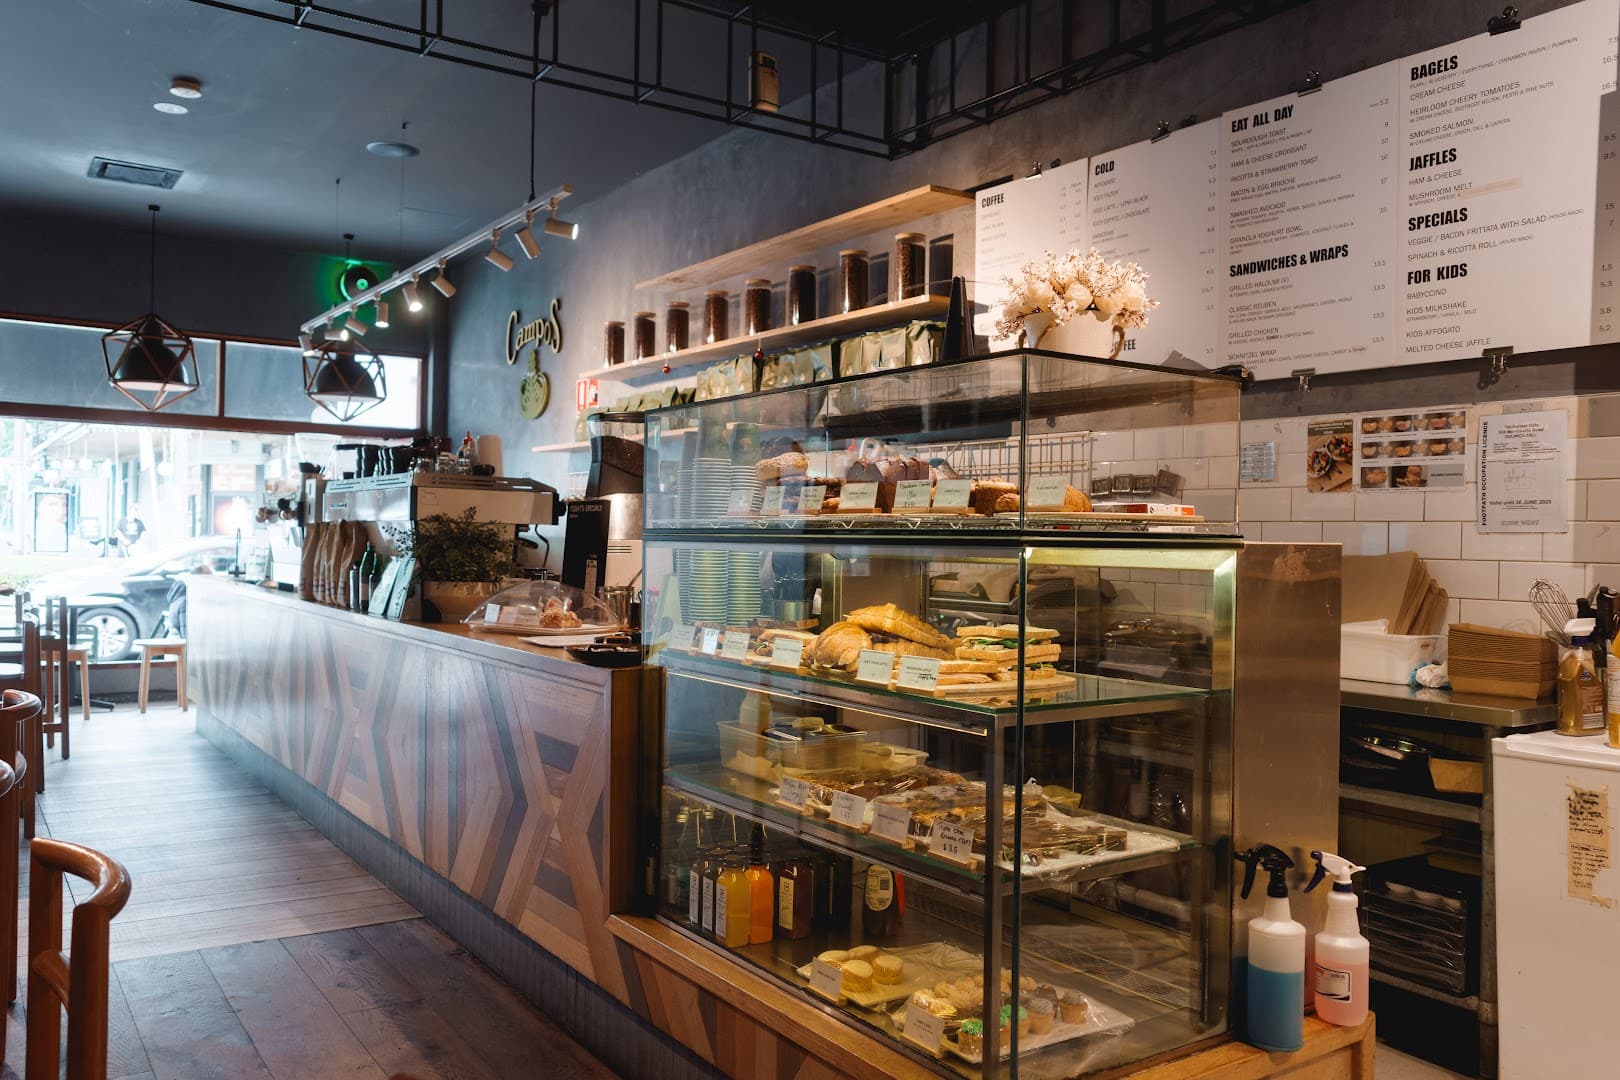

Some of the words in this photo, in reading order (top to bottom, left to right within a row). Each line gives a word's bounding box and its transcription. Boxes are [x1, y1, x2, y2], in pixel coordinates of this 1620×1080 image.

[1411, 56, 1458, 81] BAGELS
[1410, 88, 1436, 100] CREAM
[1437, 80, 1466, 94] CHEESE
[1410, 102, 1447, 116] HEIRLOOM
[1480, 81, 1520, 98] TOMATOES
[1232, 118, 1248, 133] EAT
[1253, 112, 1270, 128] ALL
[1274, 104, 1294, 122] DAY
[1231, 132, 1268, 148] SOURDOUGH
[1269, 128, 1286, 138] TOAST
[1410, 127, 1440, 140] SMOKED
[1442, 118, 1474, 132] SALMON
[1231, 159, 1244, 168] HAM
[1252, 153, 1273, 164] CHEESE
[1274, 144, 1307, 158] CROISSANT
[1409, 148, 1456, 171] JAFFLES
[1095, 160, 1114, 176] COLD
[1230, 173, 1254, 182] RICOTTA
[1260, 161, 1299, 176] STRAWBERRY
[1300, 156, 1318, 166] TOAST
[1409, 177, 1426, 186] HAM
[1434, 168, 1463, 181] CHEESE
[1230, 188, 1250, 197] BACON
[1270, 177, 1296, 188] BRIOCHE
[1409, 186, 1452, 200] MUSHROOM
[1454, 182, 1472, 192] MELT
[982, 193, 1004, 208] COFFEE
[1230, 208, 1258, 218] SMASHED
[1260, 201, 1286, 212] AVOCADO
[1408, 208, 1468, 231] SPECIALS
[1230, 234, 1256, 244] GRANOLA
[1258, 228, 1284, 238] YOGHURT
[1286, 225, 1302, 233] BOWL
[1408, 236, 1432, 246] VEGGIE
[1440, 230, 1465, 240] BACON
[1467, 224, 1498, 234] FRITTATA
[1500, 220, 1519, 230] WITH
[1522, 215, 1546, 226] SALAD
[1230, 254, 1297, 277] SANDWICHES
[1300, 255, 1307, 266] &
[1310, 244, 1348, 263] WRAPS
[1408, 250, 1438, 262] SPINACH
[1448, 244, 1476, 254] RICOTTA
[1478, 240, 1498, 250] ROLL
[1408, 269, 1430, 285] FOR
[1437, 263, 1468, 280] KIDS
[1229, 282, 1254, 292] GRILLED
[1229, 304, 1252, 314] CLASSIC
[1254, 301, 1276, 310] REUBEN
[1425, 301, 1468, 312] MILKSHAKE
[1228, 330, 1252, 338] GRILLED
[1254, 328, 1278, 336] CHICKEN
[1406, 330, 1422, 338] KIDS
[1424, 326, 1461, 336] AFFOGATO
[1228, 352, 1258, 360] SCHNITZEL
[1260, 349, 1276, 357] WRAP
[1406, 344, 1433, 352] MELTED
[1436, 340, 1464, 350] CHEESE
[1466, 338, 1492, 347] JAFFLE
